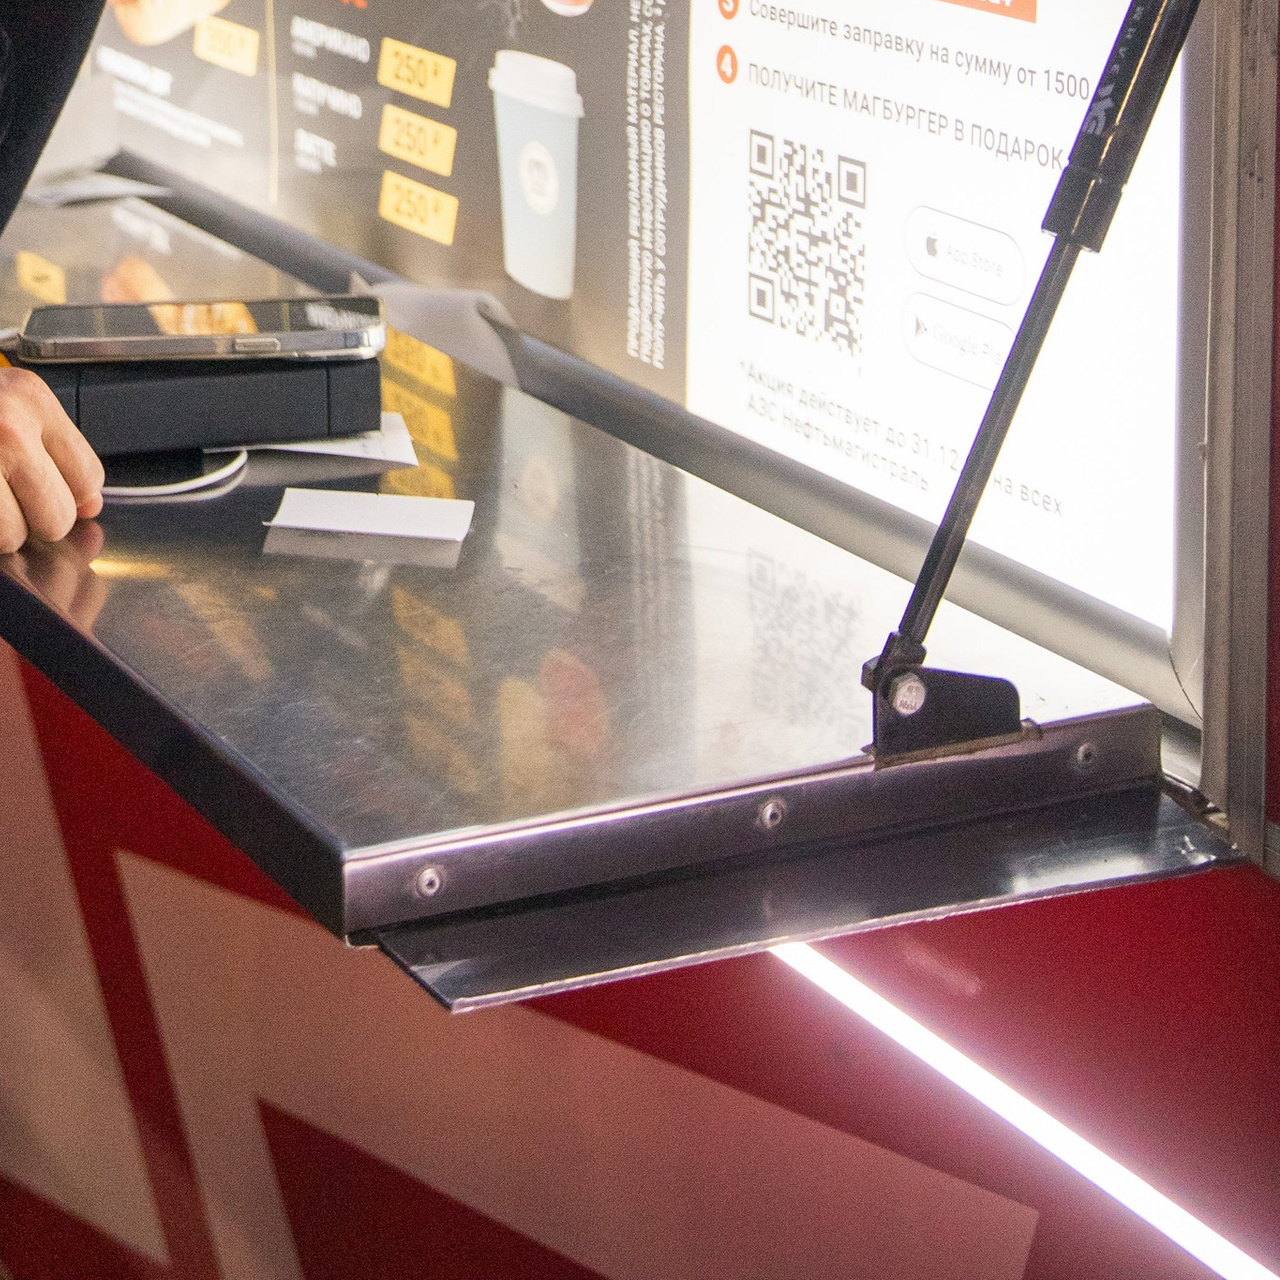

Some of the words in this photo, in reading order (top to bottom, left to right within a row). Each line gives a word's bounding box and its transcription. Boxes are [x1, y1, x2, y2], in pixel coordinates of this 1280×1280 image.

[639, 103, 651, 117] О
[843, 22, 924, 63] заправку
[929, 42, 950, 65] на
[955, 50, 1012, 87] сумму
[1017, 66, 1037, 87] от
[1043, 69, 1090, 101] 1500
[748, 62, 838, 107] ПОЛУЧИТЕ
[843, 89, 948, 137] МАГБУРГЕР
[954, 118, 965, 141] В
[971, 123, 1063, 172] ПОДАРОК
[626, 125, 640, 237] РЕКЛАМНЫЙ
[798, 389, 880, 437] действует
[885, 428, 906, 450] до
[992, 473, 1014, 496] на
[1020, 483, 1064, 517] всех
